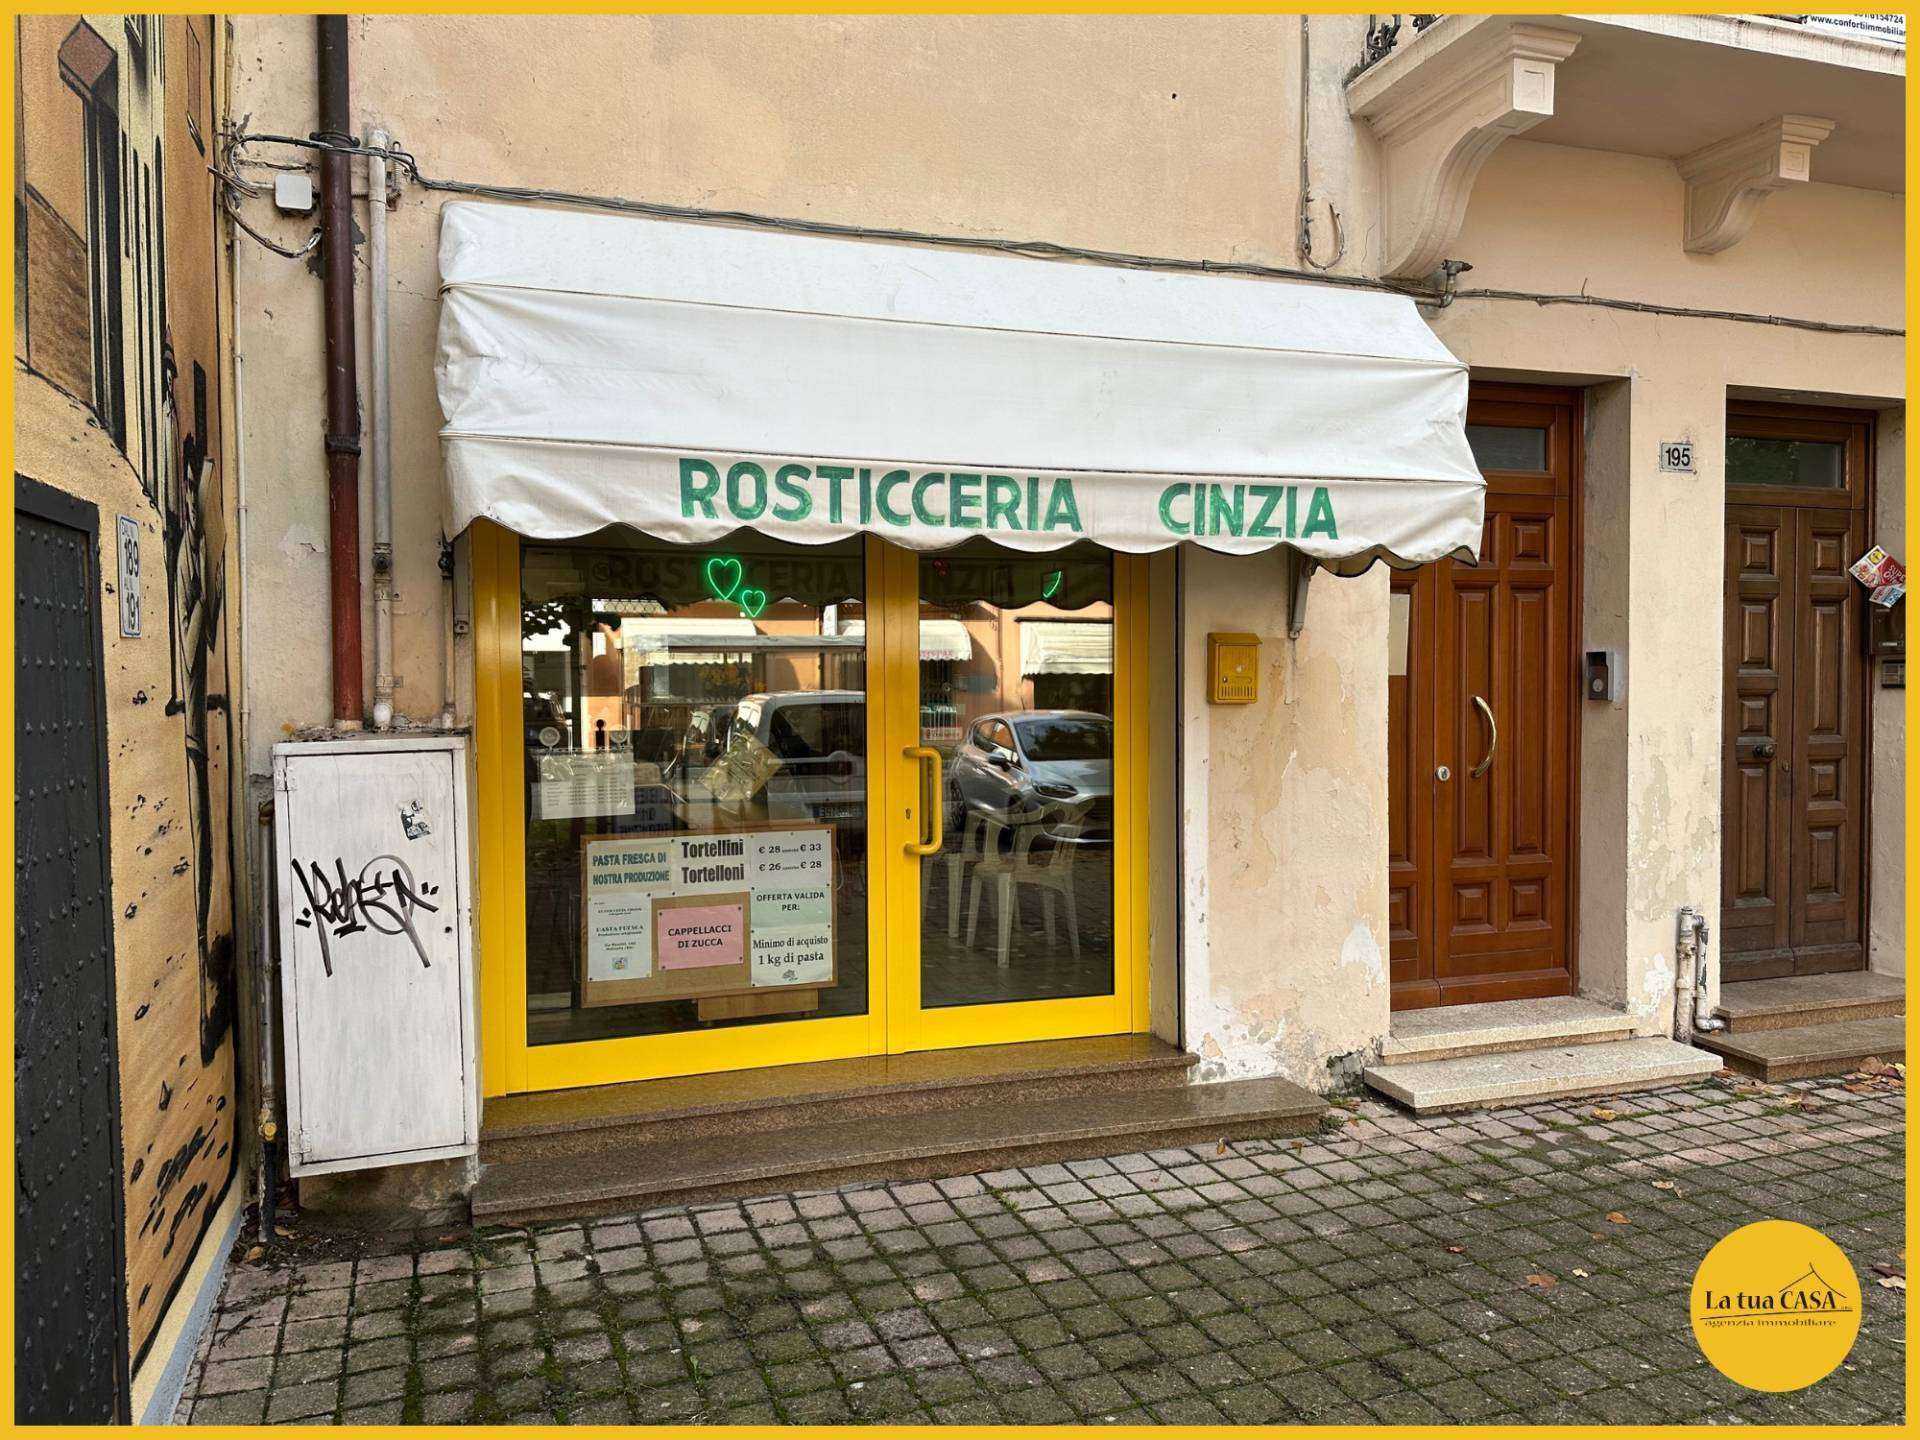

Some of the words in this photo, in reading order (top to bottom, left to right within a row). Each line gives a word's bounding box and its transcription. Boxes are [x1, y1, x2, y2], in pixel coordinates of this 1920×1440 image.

[1665, 447, 1690, 467] 195
[678, 457, 1083, 533] ROSTICCERIA
[1158, 482, 1339, 540] CINZIA
[124, 538, 139, 577] 189
[126, 591, 140, 632] 191
[681, 840, 744, 858] Tortellini
[758, 846, 766, 854] €
[768, 845, 781, 854] 28
[799, 844, 807, 852] €
[809, 843, 822, 852] 33
[592, 854, 620, 866] PASTA
[622, 853, 656, 865] FRESCA
[657, 852, 667, 863] DI
[758, 863, 766, 872] €
[768, 863, 782, 871] 26
[800, 861, 807, 869] €
[809, 860, 822, 869] 28
[592, 873, 623, 885] NOSTRA
[624, 871, 670, 883] PRODUZIONE
[681, 864, 744, 883] Tortelloni
[756, 893, 793, 902] OFFERTA
[794, 891, 825, 900] VALIDA
[781, 903, 801, 912] PER:
[667, 925, 732, 937] CAPPELLACCI
[691, 938, 723, 948] ZUCCA
[753, 939, 785, 949] Minimo
[786, 937, 795, 947] di
[796, 935, 829, 948] acquisto
[758, 955, 764, 965] 1
[767, 954, 781, 967] kg
[783, 952, 794, 963] di
[797, 951, 824, 965] pasta
